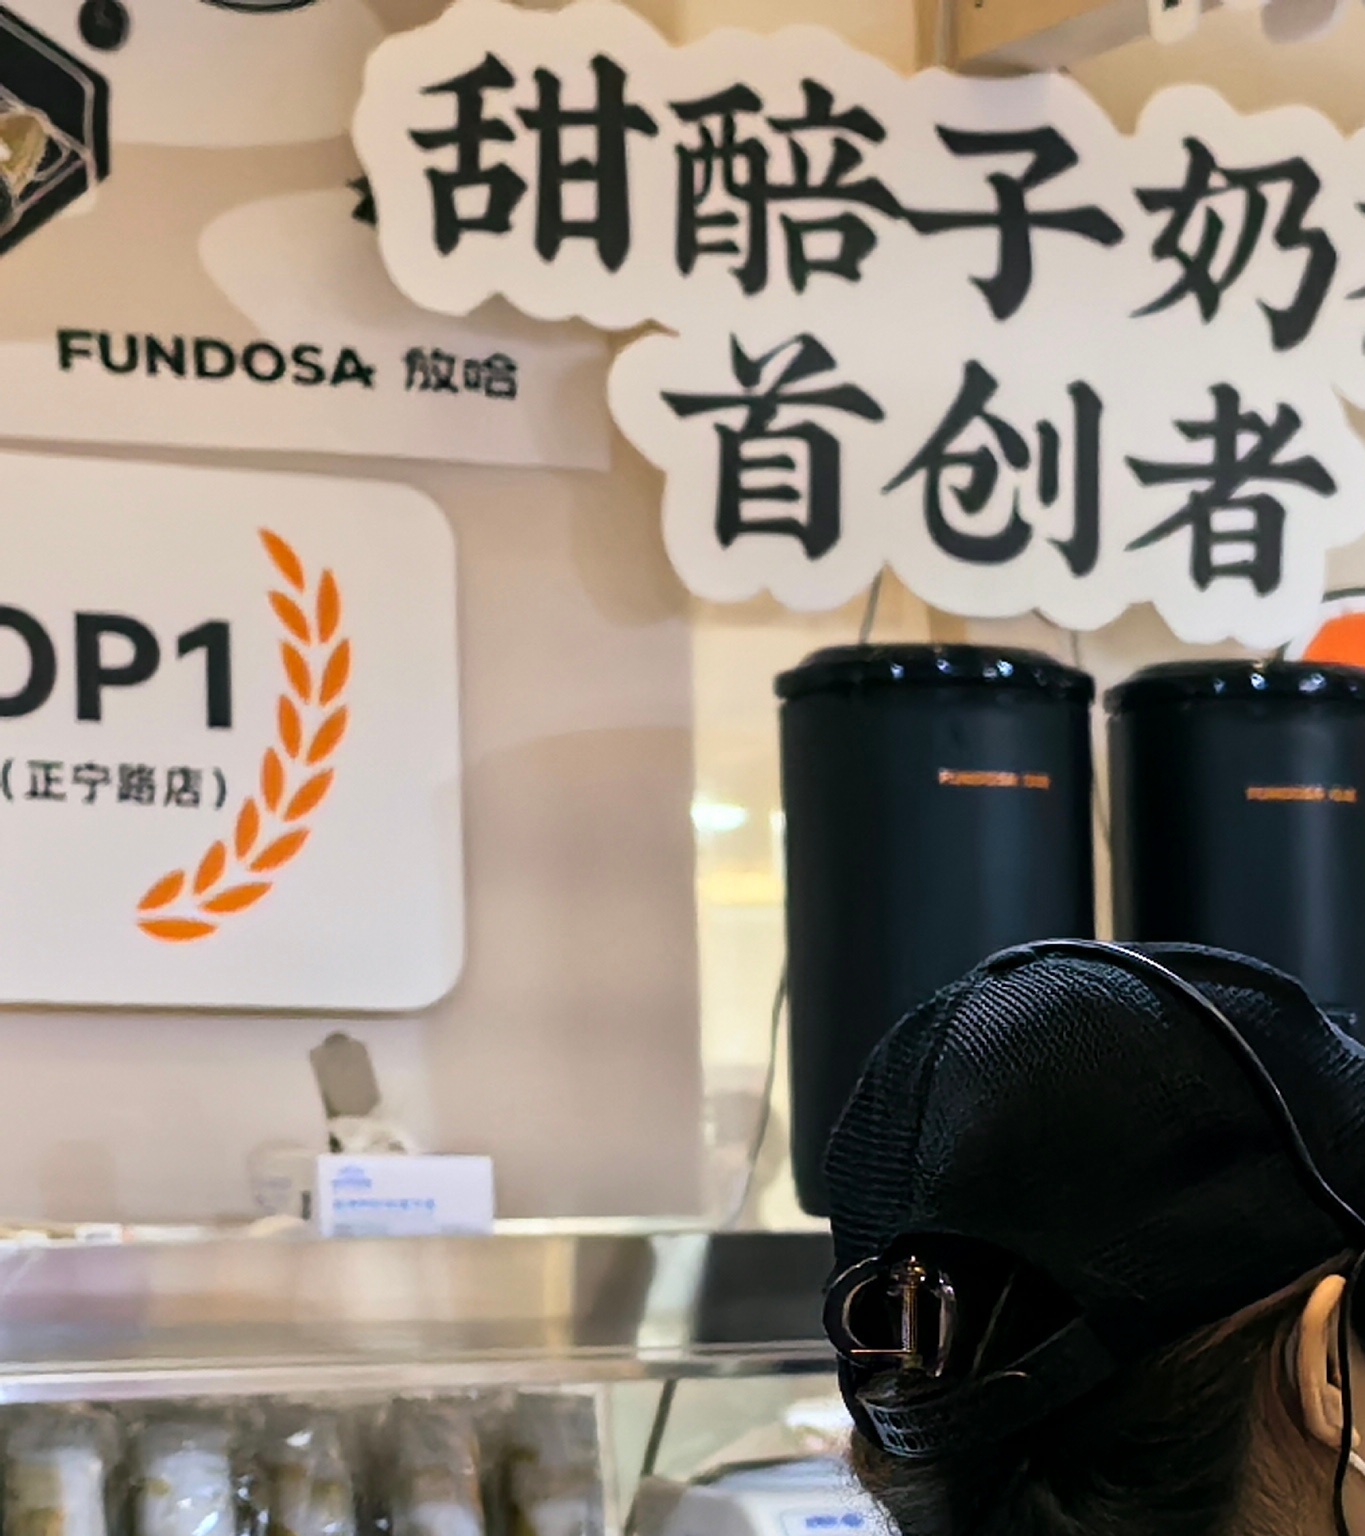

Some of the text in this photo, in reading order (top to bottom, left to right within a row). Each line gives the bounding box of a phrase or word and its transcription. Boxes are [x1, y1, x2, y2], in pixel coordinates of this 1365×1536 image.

[56, 328, 376, 390] FUNDOSA
[660, 332, 1338, 598] 首创者
